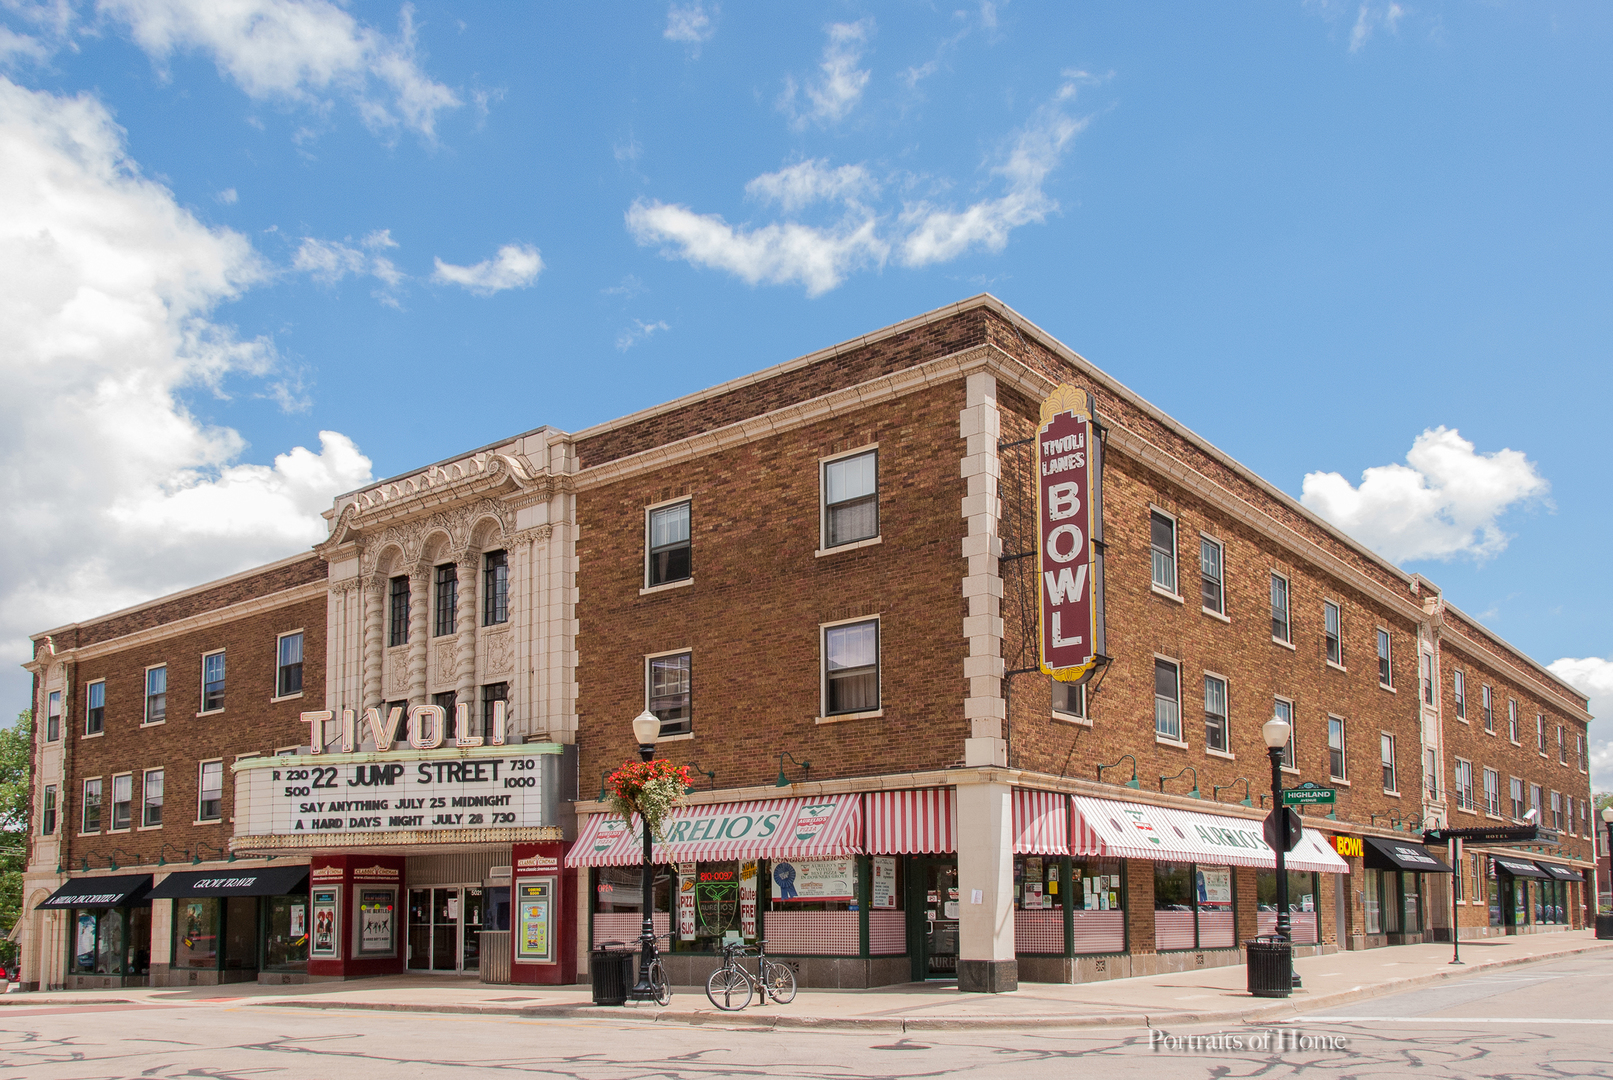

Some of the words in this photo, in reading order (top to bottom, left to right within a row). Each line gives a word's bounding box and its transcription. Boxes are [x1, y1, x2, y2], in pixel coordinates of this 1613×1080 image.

[1042, 433, 1085, 457] TIVOLI
[1042, 452, 1085, 476] LANES
[1044, 481, 1088, 648] BOWL
[300, 700, 506, 755] TIVOLI
[311, 766, 338, 788] 22
[347, 764, 405, 787] JUMP
[417, 759, 504, 784] STREET
[510, 759, 536, 771] 730
[272, 770, 281, 781] R
[286, 770, 309, 780] 230
[504, 776, 536, 788] 1000
[284, 786, 310, 797] 500
[300, 802, 326, 813] SAY
[328, 800, 389, 812] ANYTHING
[395, 798, 426, 810] JULY
[429, 798, 446, 808] 25
[452, 795, 512, 808] MIDNIGHT
[294, 819, 304, 830] A
[312, 818, 344, 830] HARD
[349, 817, 382, 828] DAYS
[388, 815, 424, 827] NIGHT
[432, 814, 464, 825] JULY
[468, 814, 484, 825] 28
[492, 812, 516, 824] 730
[1194, 824, 1270, 850] AURELIO'S
[1336, 836, 1364, 857] BOWL
[700, 872, 733, 880] 810-0097
[597, 884, 613, 892] OPEN
